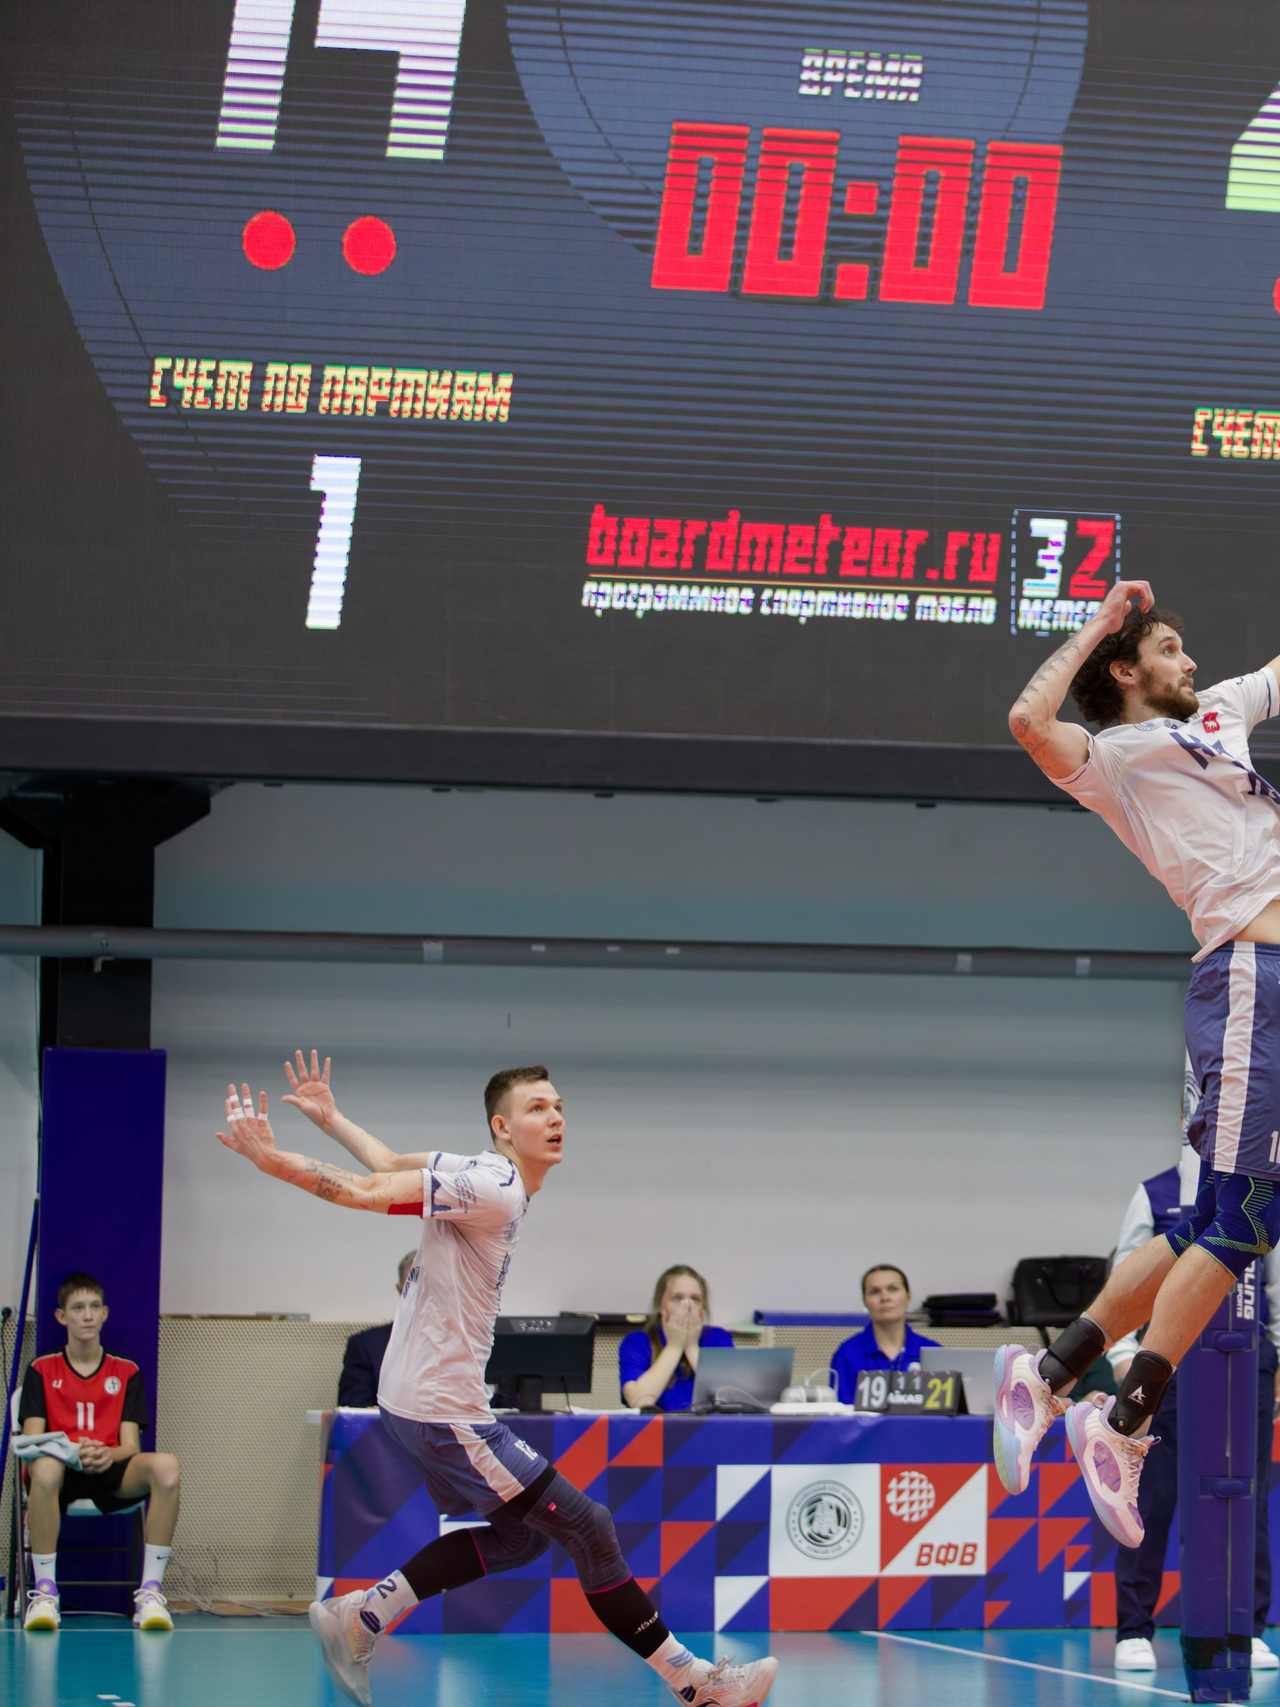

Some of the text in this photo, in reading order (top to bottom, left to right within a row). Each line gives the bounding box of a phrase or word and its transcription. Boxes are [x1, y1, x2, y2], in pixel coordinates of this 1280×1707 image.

[798, 48, 923, 102] ВРЕМЯ
[651, 121, 1064, 310] 00:00
[149, 357, 513, 423] СЧЕТ ПО ПАРТИЯМ
[305, 454, 361, 630] 1
[586, 503, 1001, 582] boardmeteor.ru
[915, 594, 998, 625] табло
[1236, 1282, 1244, 1319] SPORTS
[858, 1376, 888, 1409] 19
[925, 1377, 954, 1409] 21
[76, 1401, 95, 1431] 11
[916, 1542, 978, 1567] ВФВ
